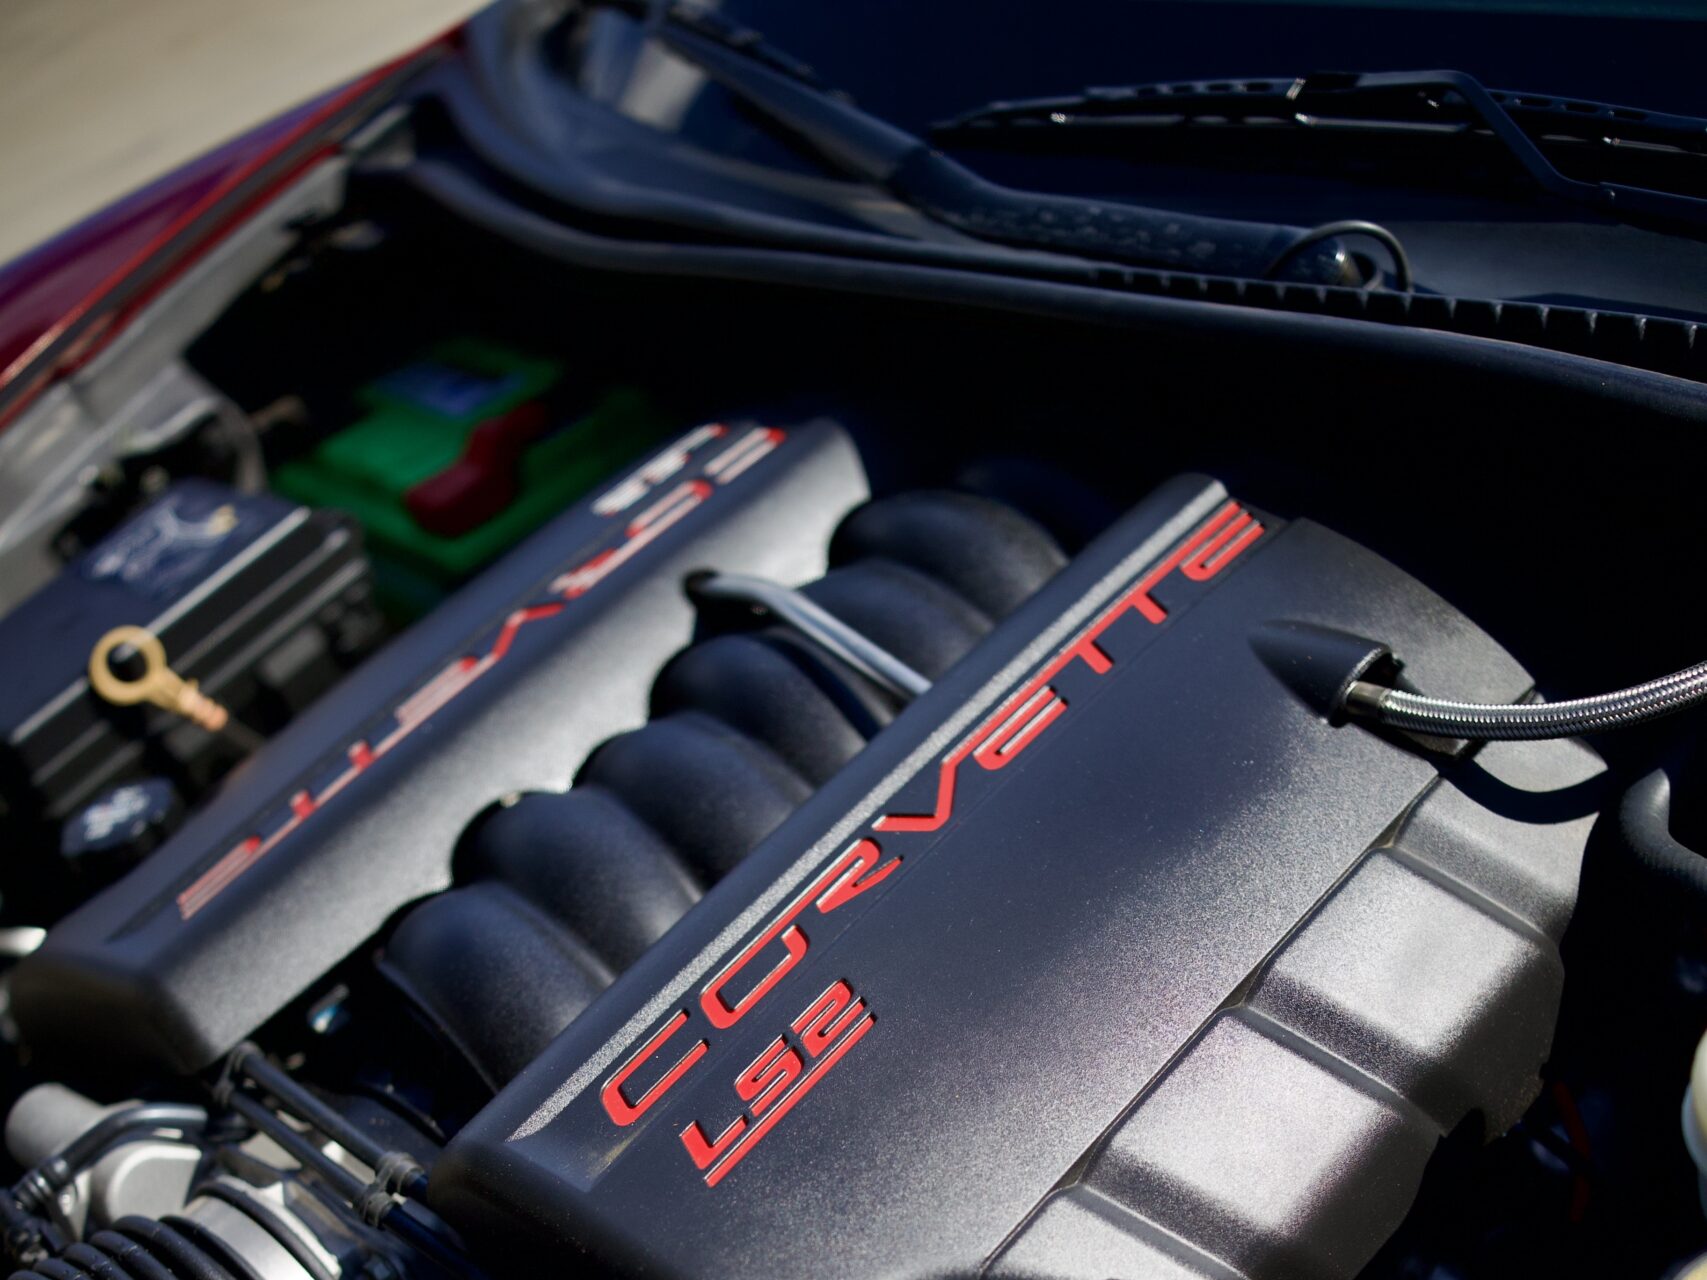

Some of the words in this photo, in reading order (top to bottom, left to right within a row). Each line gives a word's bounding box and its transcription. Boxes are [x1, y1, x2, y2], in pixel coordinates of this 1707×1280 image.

[178, 427, 787, 921] CORVETTE
[601, 500, 1264, 1127] CORVETTE
[680, 978, 868, 1170] LS2
